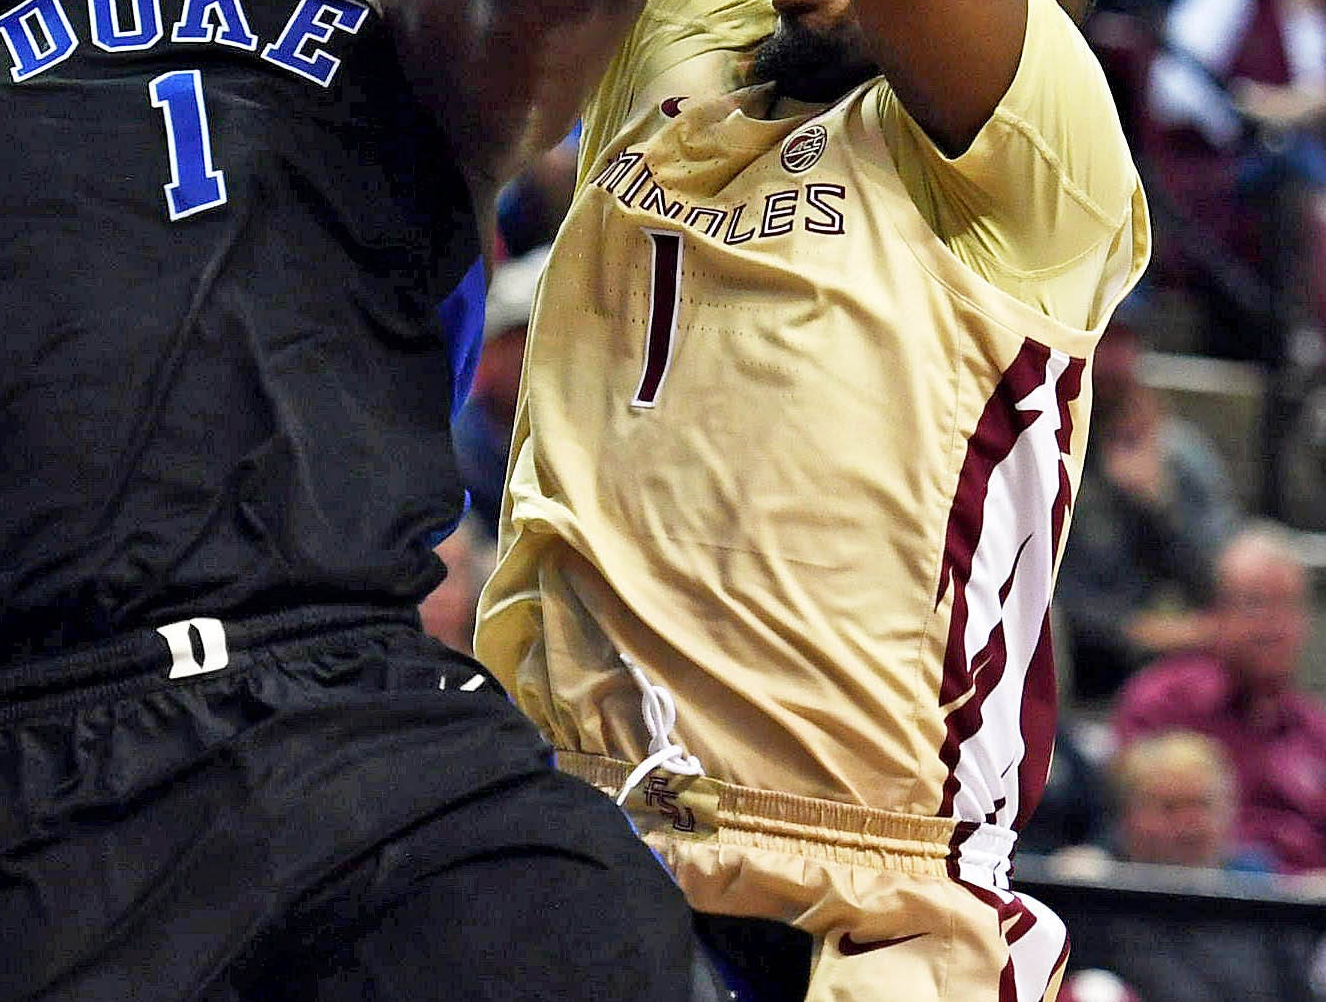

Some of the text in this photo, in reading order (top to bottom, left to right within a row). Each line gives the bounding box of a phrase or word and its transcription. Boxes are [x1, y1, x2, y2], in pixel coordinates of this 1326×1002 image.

[149, 69, 227, 221] 1
[630, 226, 685, 409] 1
[156, 617, 229, 679] D
[644, 776, 695, 832] FSU
